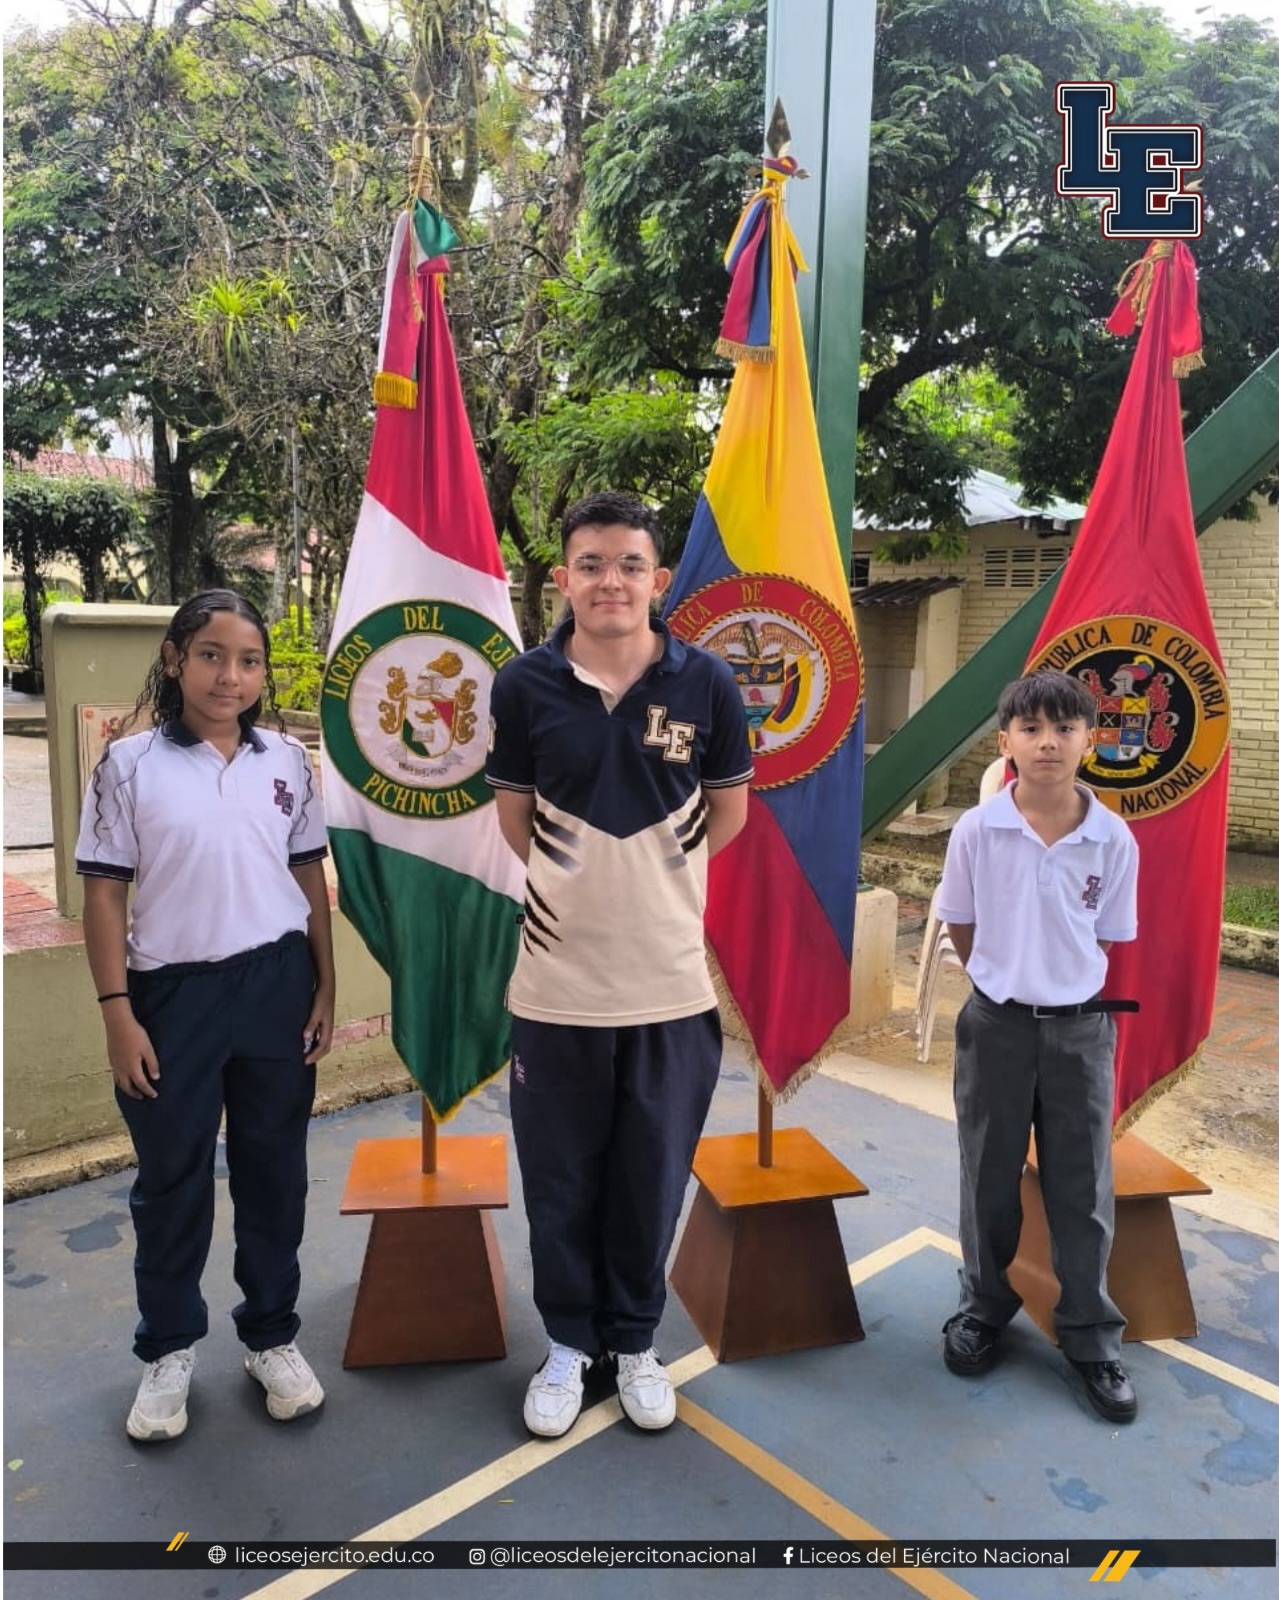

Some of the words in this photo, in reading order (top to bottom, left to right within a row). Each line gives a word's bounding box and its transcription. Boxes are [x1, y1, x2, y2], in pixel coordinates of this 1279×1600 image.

[325, 634, 372, 700] LICEOS
[403, 605, 444, 631] DEL
[674, 601, 712, 639] LICA
[741, 581, 764, 603] DE
[800, 599, 855, 683] COLOMBIA
[1132, 623, 1157, 646] DE
[1164, 636, 1226, 720] COLOMBIA
[643, 705, 696, 764] LE
[362, 773, 477, 815] PICHINCHA
[1120, 761, 1208, 815] NACIONAL
